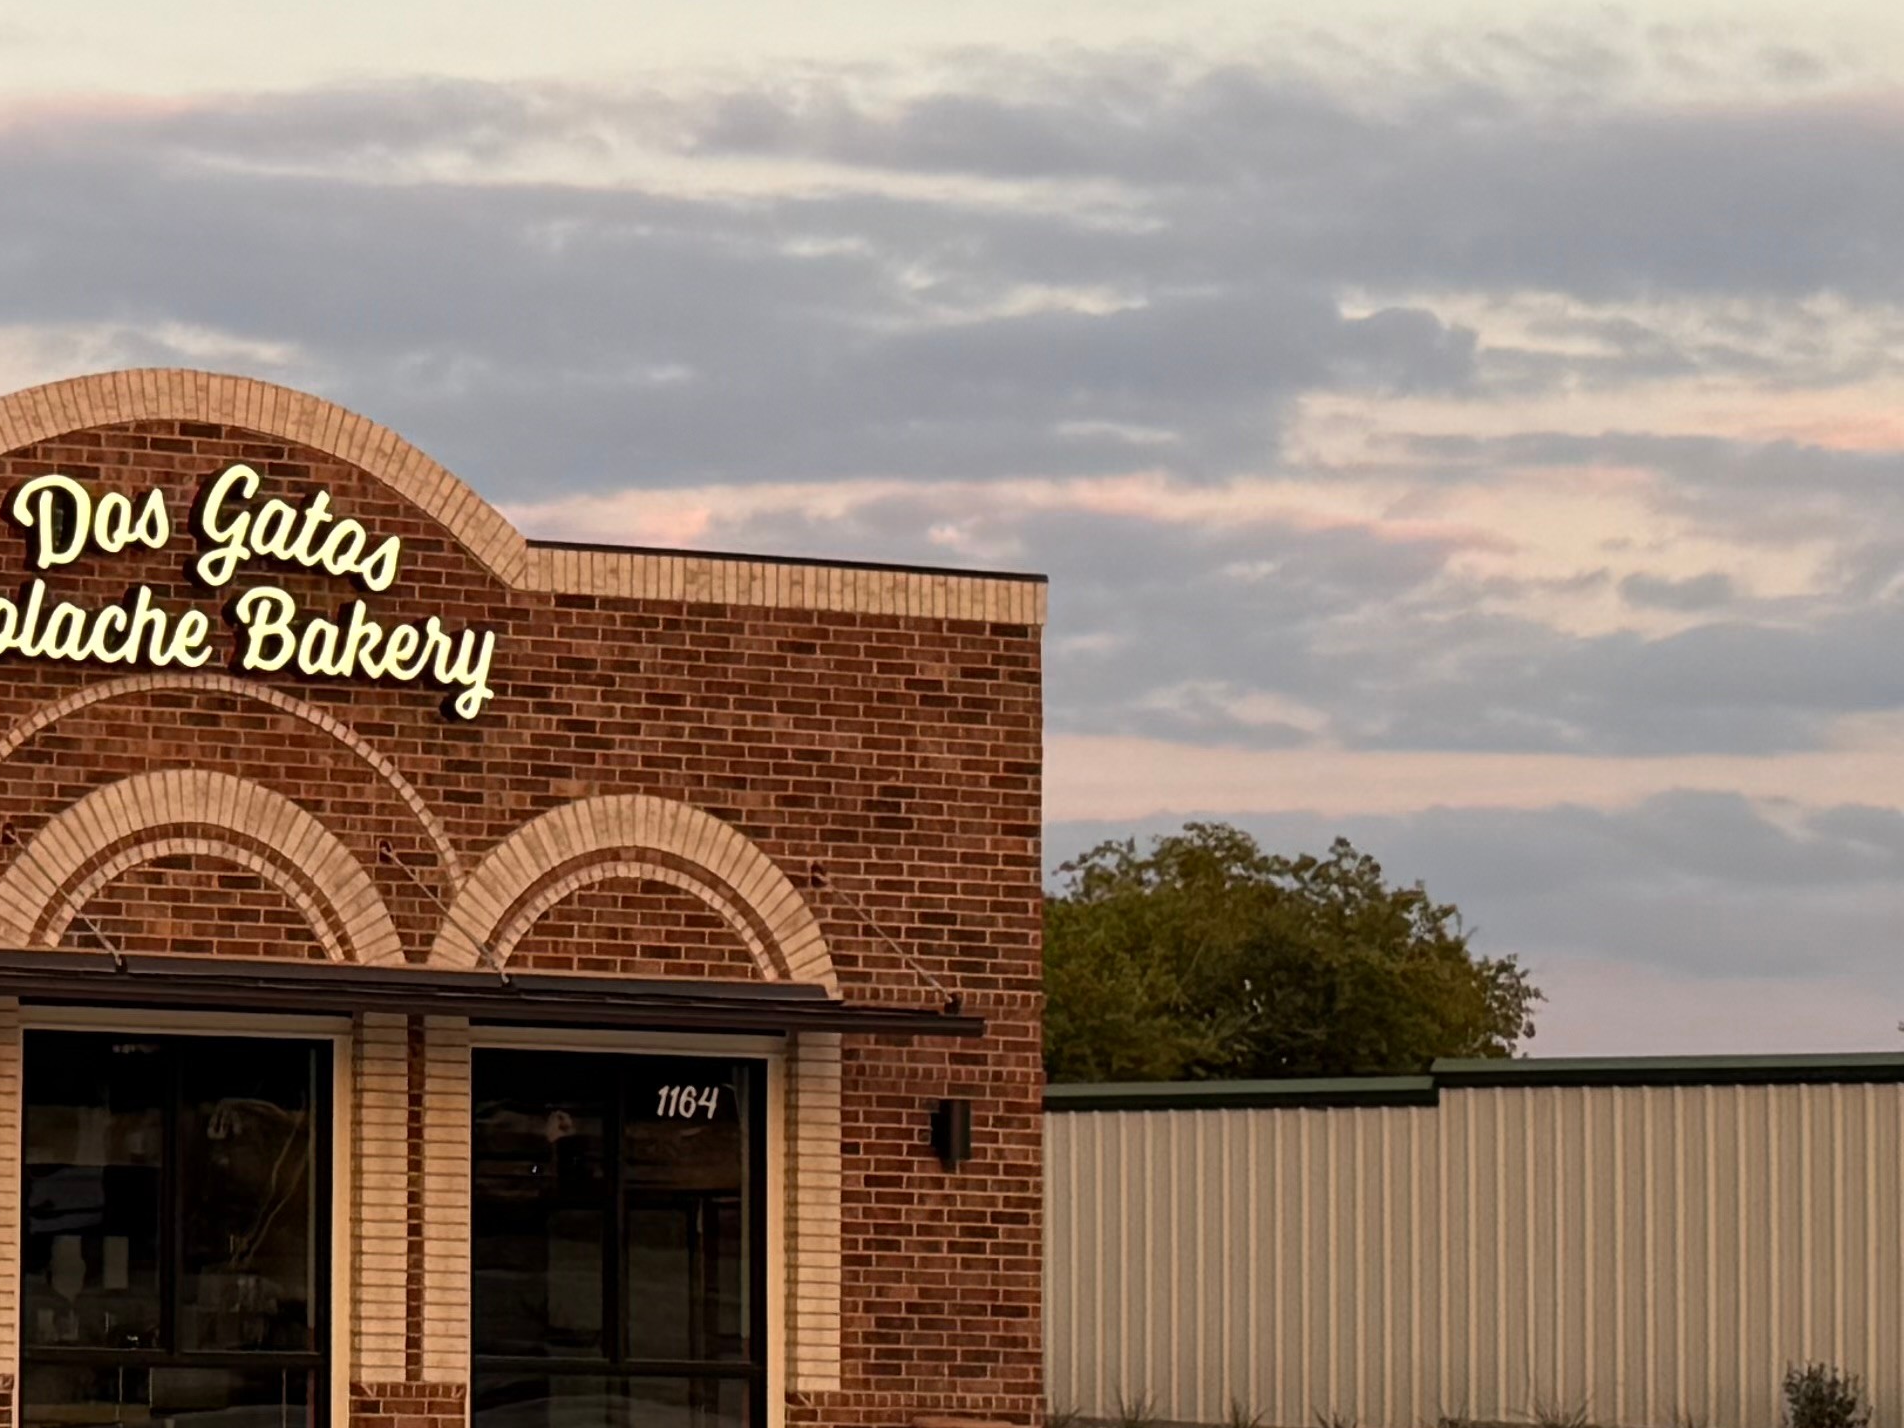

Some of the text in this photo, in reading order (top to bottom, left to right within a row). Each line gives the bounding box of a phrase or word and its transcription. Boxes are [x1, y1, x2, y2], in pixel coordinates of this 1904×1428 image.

[13, 464, 401, 592] Dos Gatos
[234, 585, 496, 721] Bakery
[656, 1084, 719, 1119] 1164
